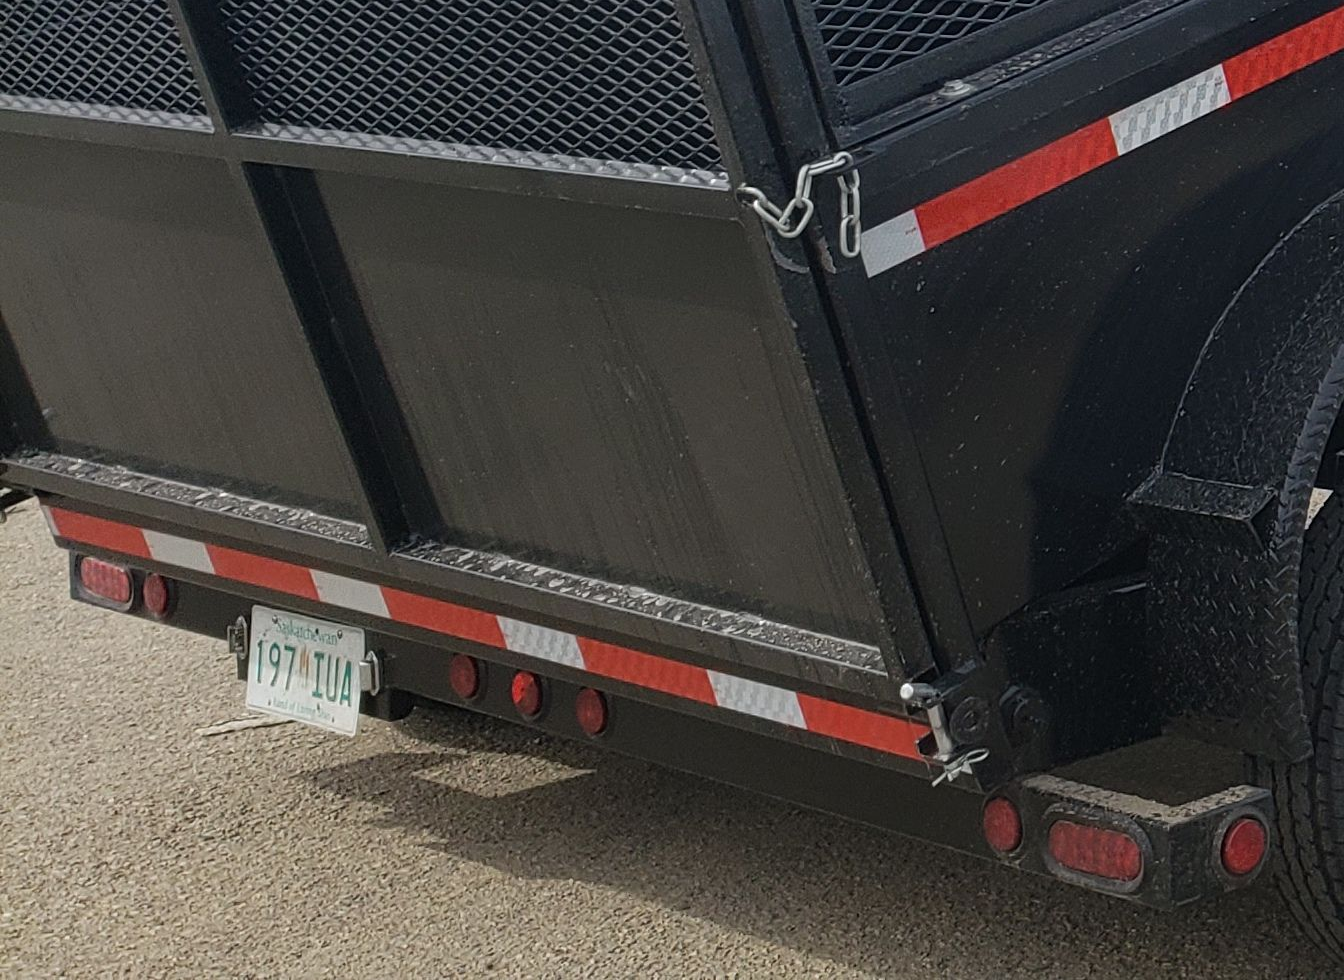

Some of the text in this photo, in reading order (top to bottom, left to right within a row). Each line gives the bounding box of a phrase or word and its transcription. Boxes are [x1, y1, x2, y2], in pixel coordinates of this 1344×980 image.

[277, 621, 338, 646] Saskatchewan
[257, 639, 352, 707] 197 IUA
